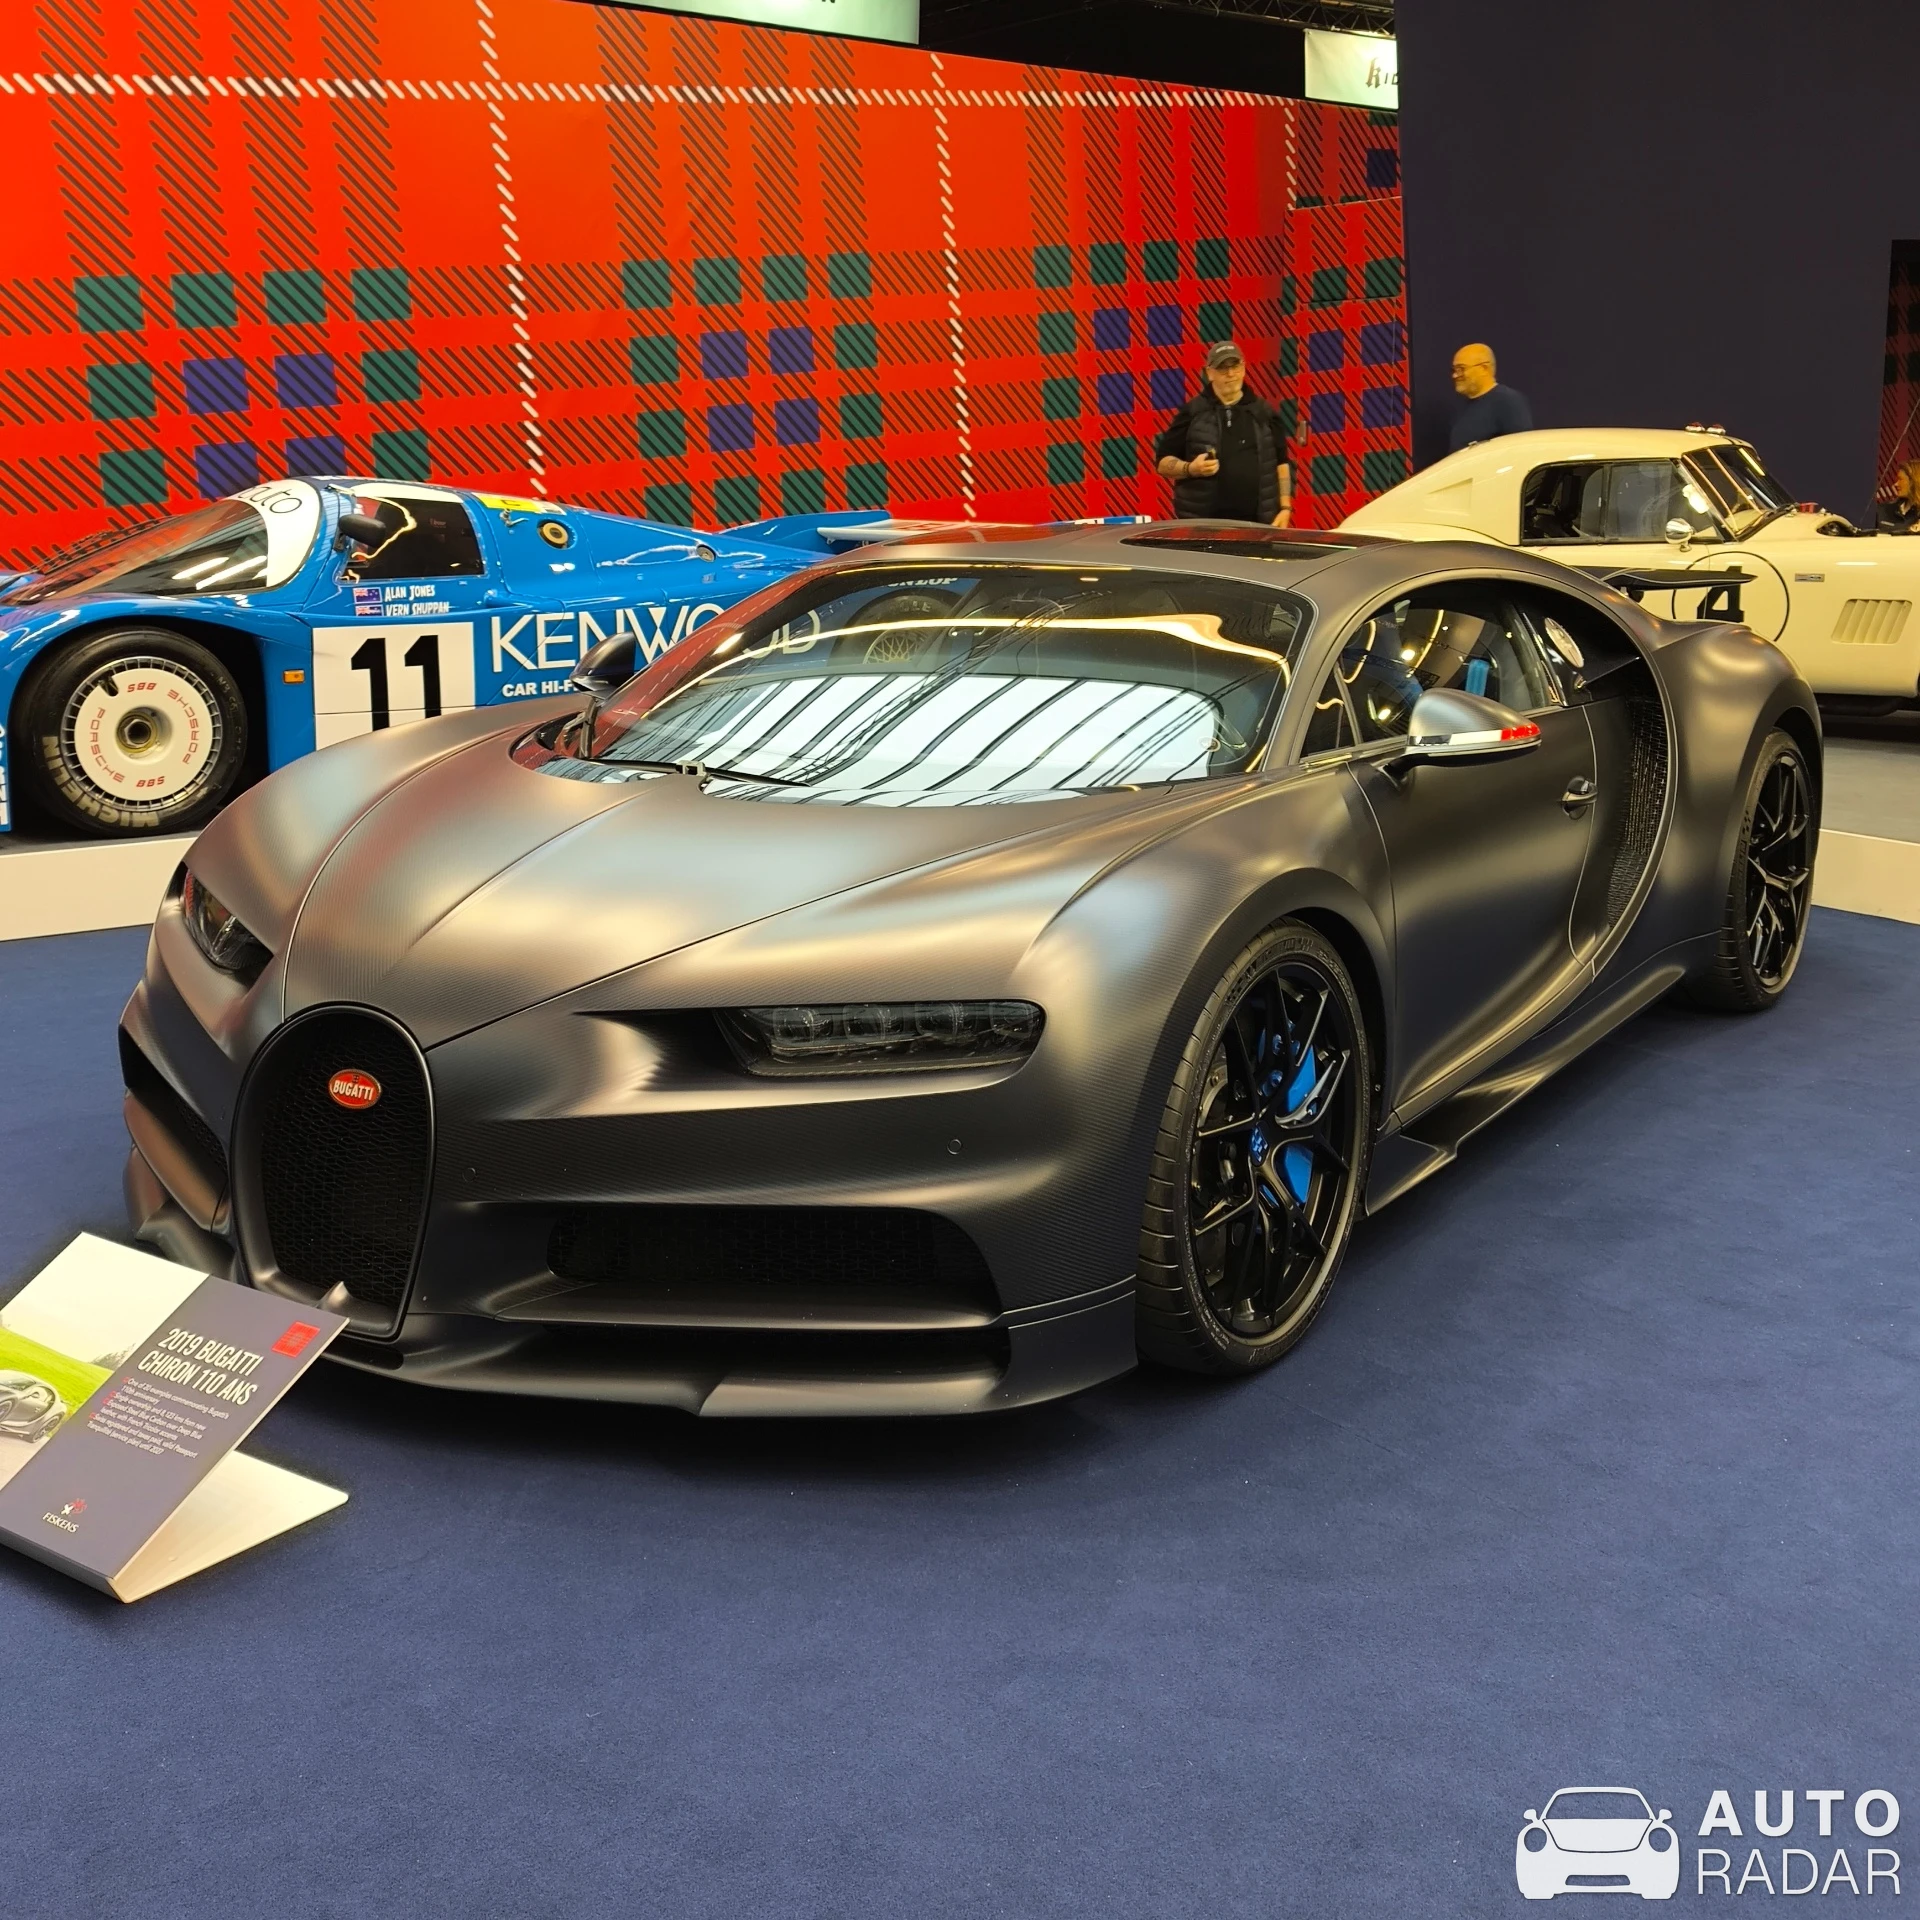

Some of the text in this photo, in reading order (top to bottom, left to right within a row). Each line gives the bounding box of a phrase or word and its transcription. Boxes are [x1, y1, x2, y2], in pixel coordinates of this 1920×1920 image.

[385, 585, 436, 602] ALAN JONES
[386, 602, 450, 616] VERN SHUPPAN
[1697, 566, 1745, 623] 4
[351, 635, 442, 732] 11
[502, 680, 579, 697] CAR HI-F
[89, 707, 125, 783] PORSCHE
[167, 689, 200, 765] PORSCHE
[42, 736, 160, 828] MICHELIN
[135, 776, 165, 788] BBS
[333, 1080, 374, 1100] BUGATTI
[158, 1328, 264, 1376] 2019 BUGATTI
[138, 1351, 258, 1405] CHIRON 110 ANS
[42, 1512, 79, 1533] FISKENS
